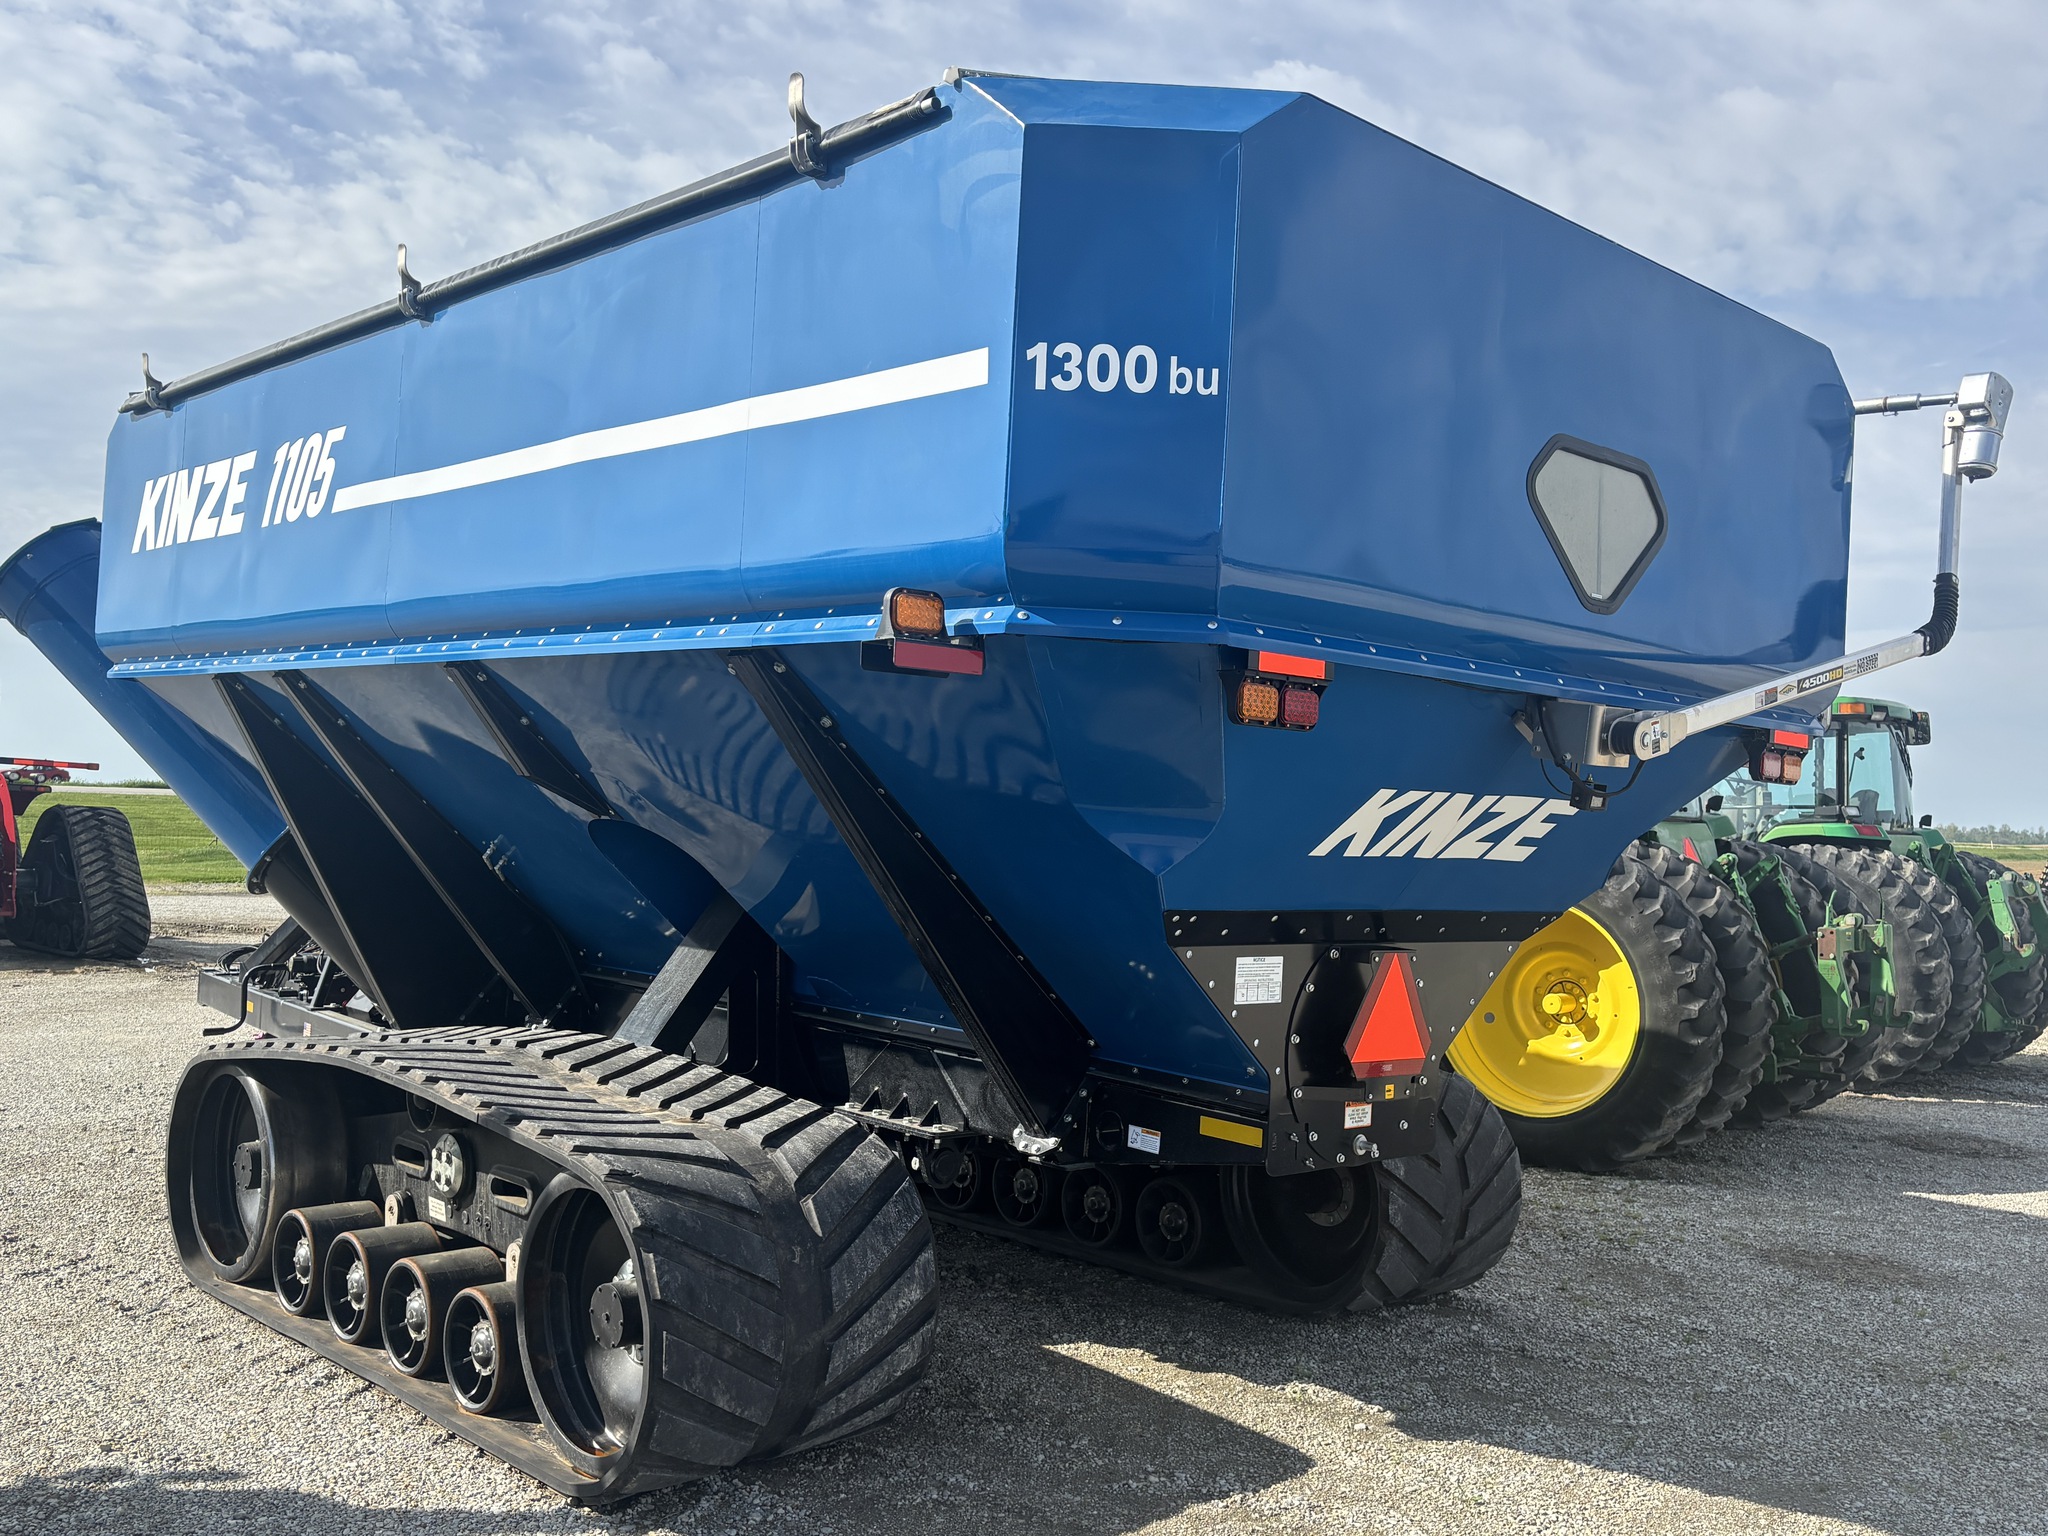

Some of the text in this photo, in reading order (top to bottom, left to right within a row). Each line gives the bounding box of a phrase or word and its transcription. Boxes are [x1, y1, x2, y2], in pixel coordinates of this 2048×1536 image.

[1026, 342, 1219, 396] 1300 bu
[131, 426, 347, 554] KINZE 1105
[1802, 667, 1843, 689] 4500HD
[1857, 662, 1866, 671] NO
[1866, 656, 1878, 668] STEP
[1307, 788, 1580, 862] KINZE
